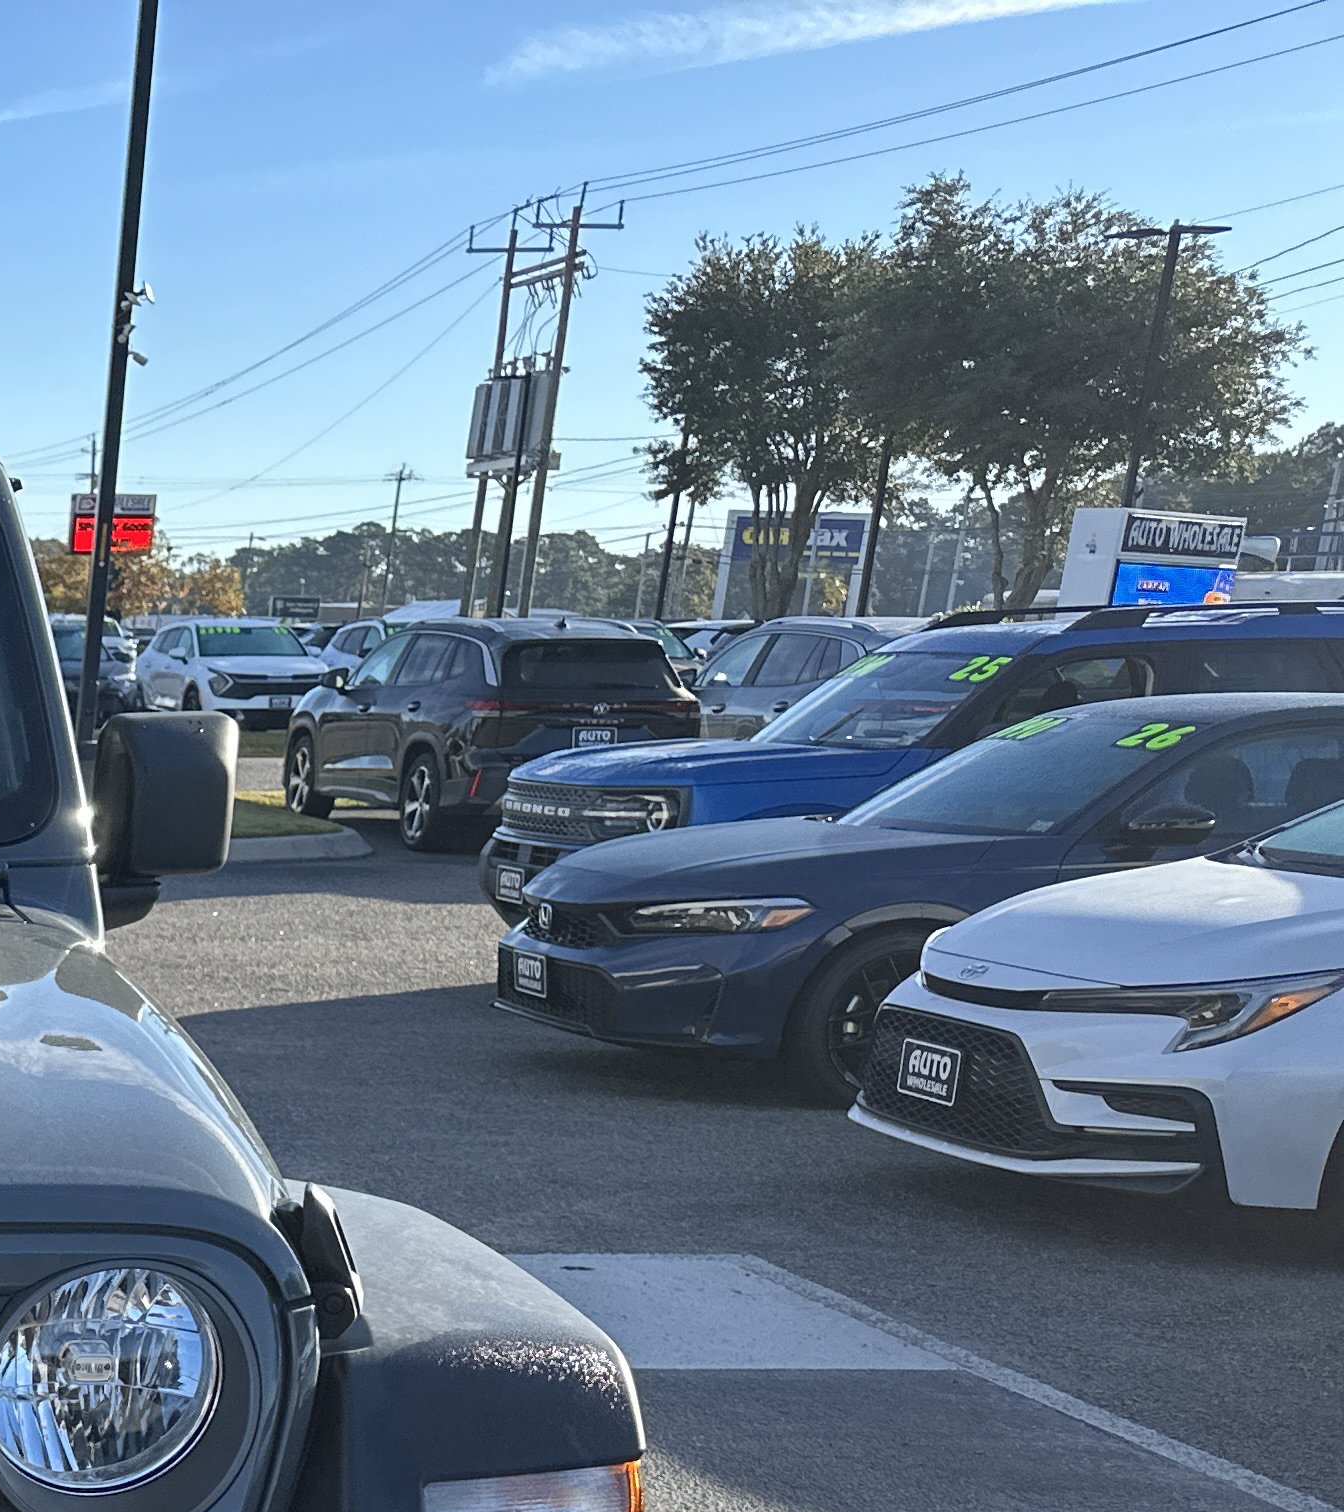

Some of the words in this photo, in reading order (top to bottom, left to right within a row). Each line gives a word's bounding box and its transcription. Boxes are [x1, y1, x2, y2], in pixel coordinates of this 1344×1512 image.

[1128, 519, 1167, 547] AUTO
[1168, 522, 1241, 553] WHOLESALE
[949, 656, 1012, 682] 25
[578, 730, 611, 741] AUTO
[1116, 723, 1196, 750] 26
[505, 800, 571, 818] BRONCO
[518, 957, 542, 979] AUTO
[908, 1049, 952, 1080] AUTO
[906, 1074, 948, 1097] WHOLESALE
